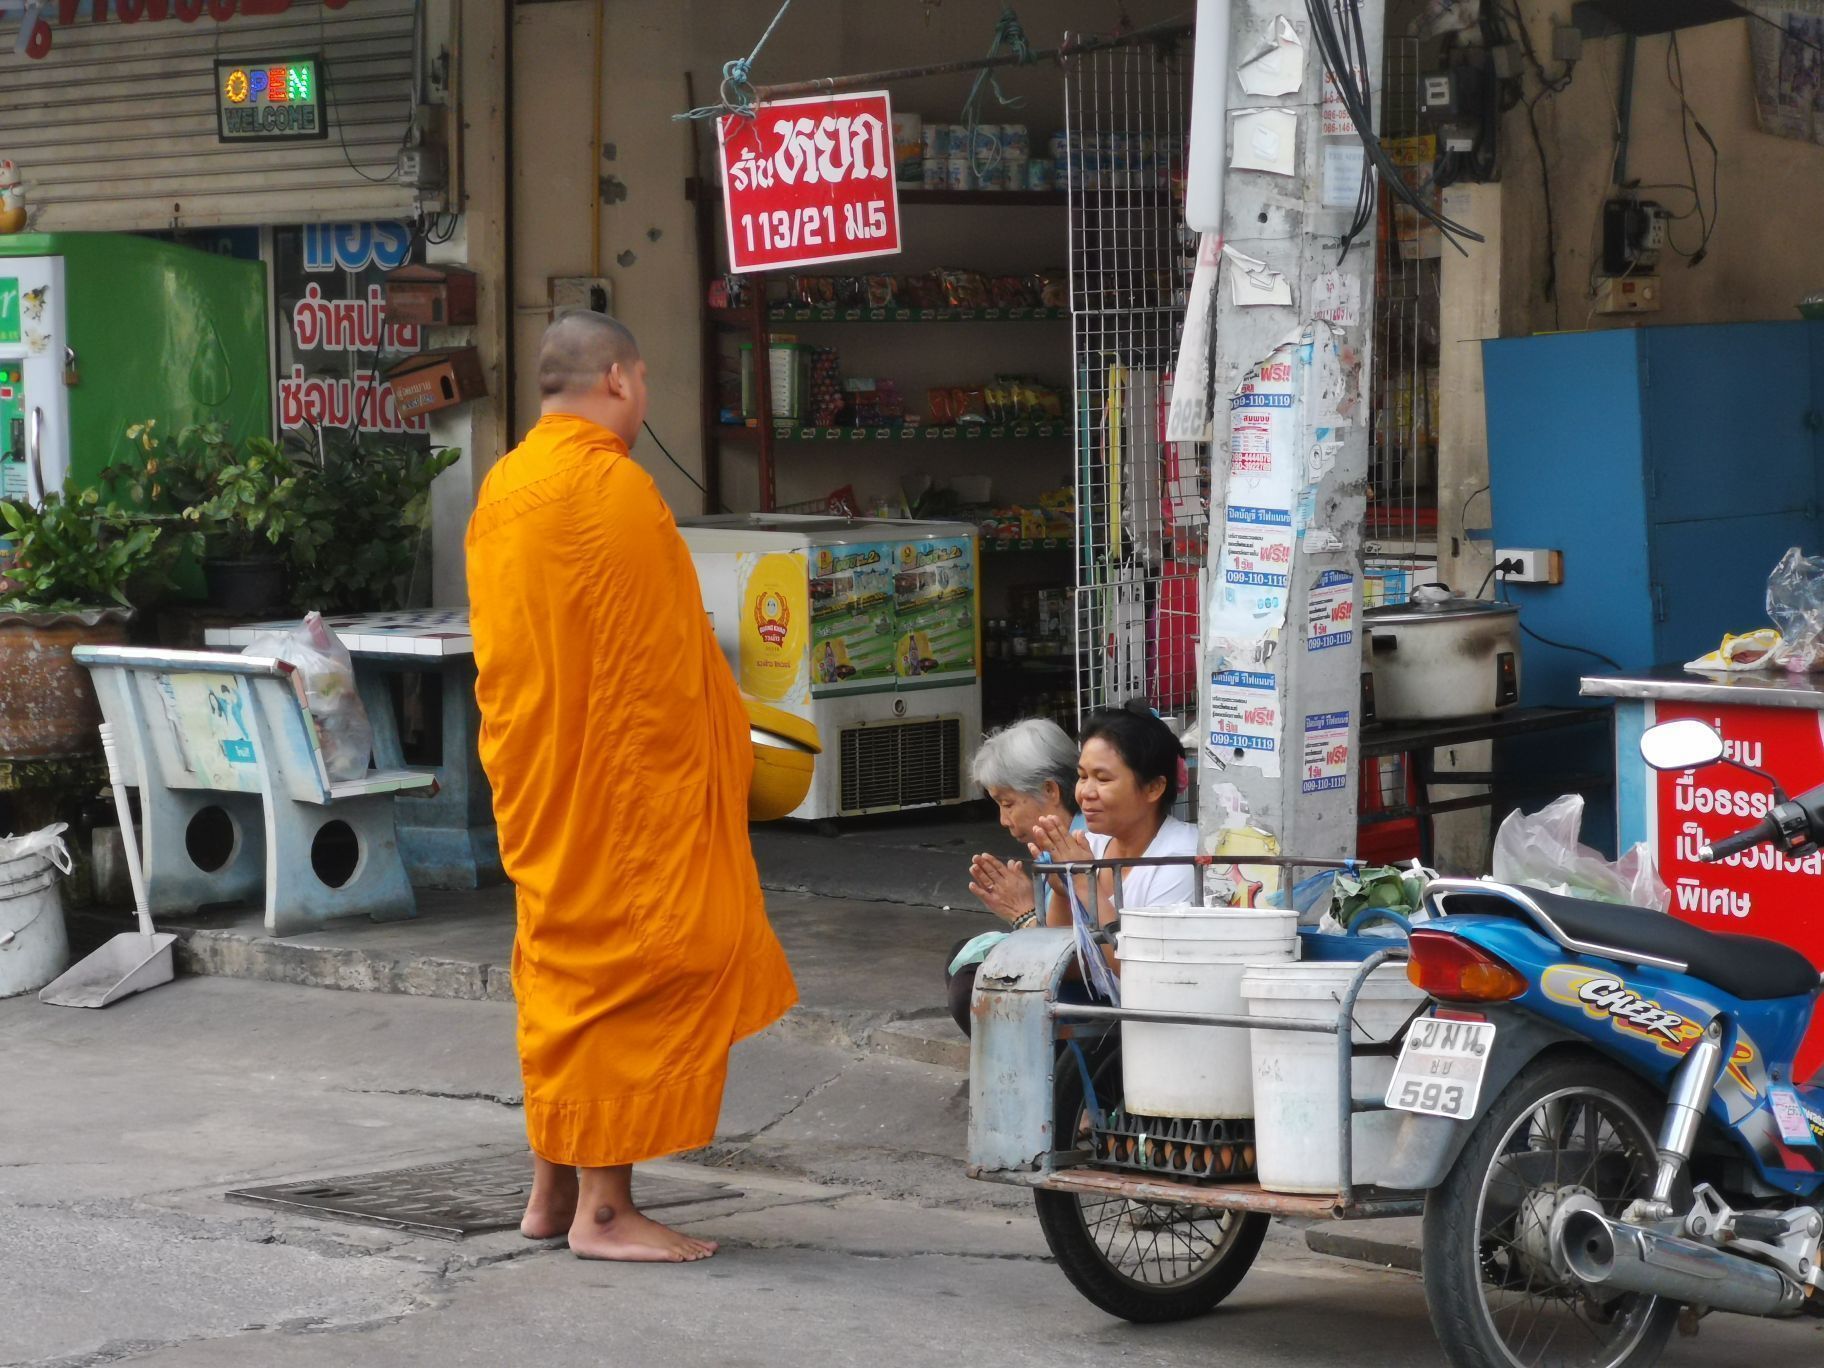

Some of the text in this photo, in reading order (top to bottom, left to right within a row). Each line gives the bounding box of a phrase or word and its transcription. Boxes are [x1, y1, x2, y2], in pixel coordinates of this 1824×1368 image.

[224, 65, 311, 104] OPEN
[224, 104, 315, 133] WELCOME
[742, 205, 836, 252] 113/21
[1231, 395, 1290, 408] 99-110-1119
[1227, 571, 1288, 586] 099-110-1119
[1308, 632, 1352, 650] 099-110-1119
[1244, 707, 1274, 726] ฟรี!!
[1212, 733, 1273, 750] 099-110-1119
[1303, 777, 1346, 792] 099-110-1119
[1675, 877, 1751, 918] พิเศษ
[1399, 1081, 1465, 1115] 593
